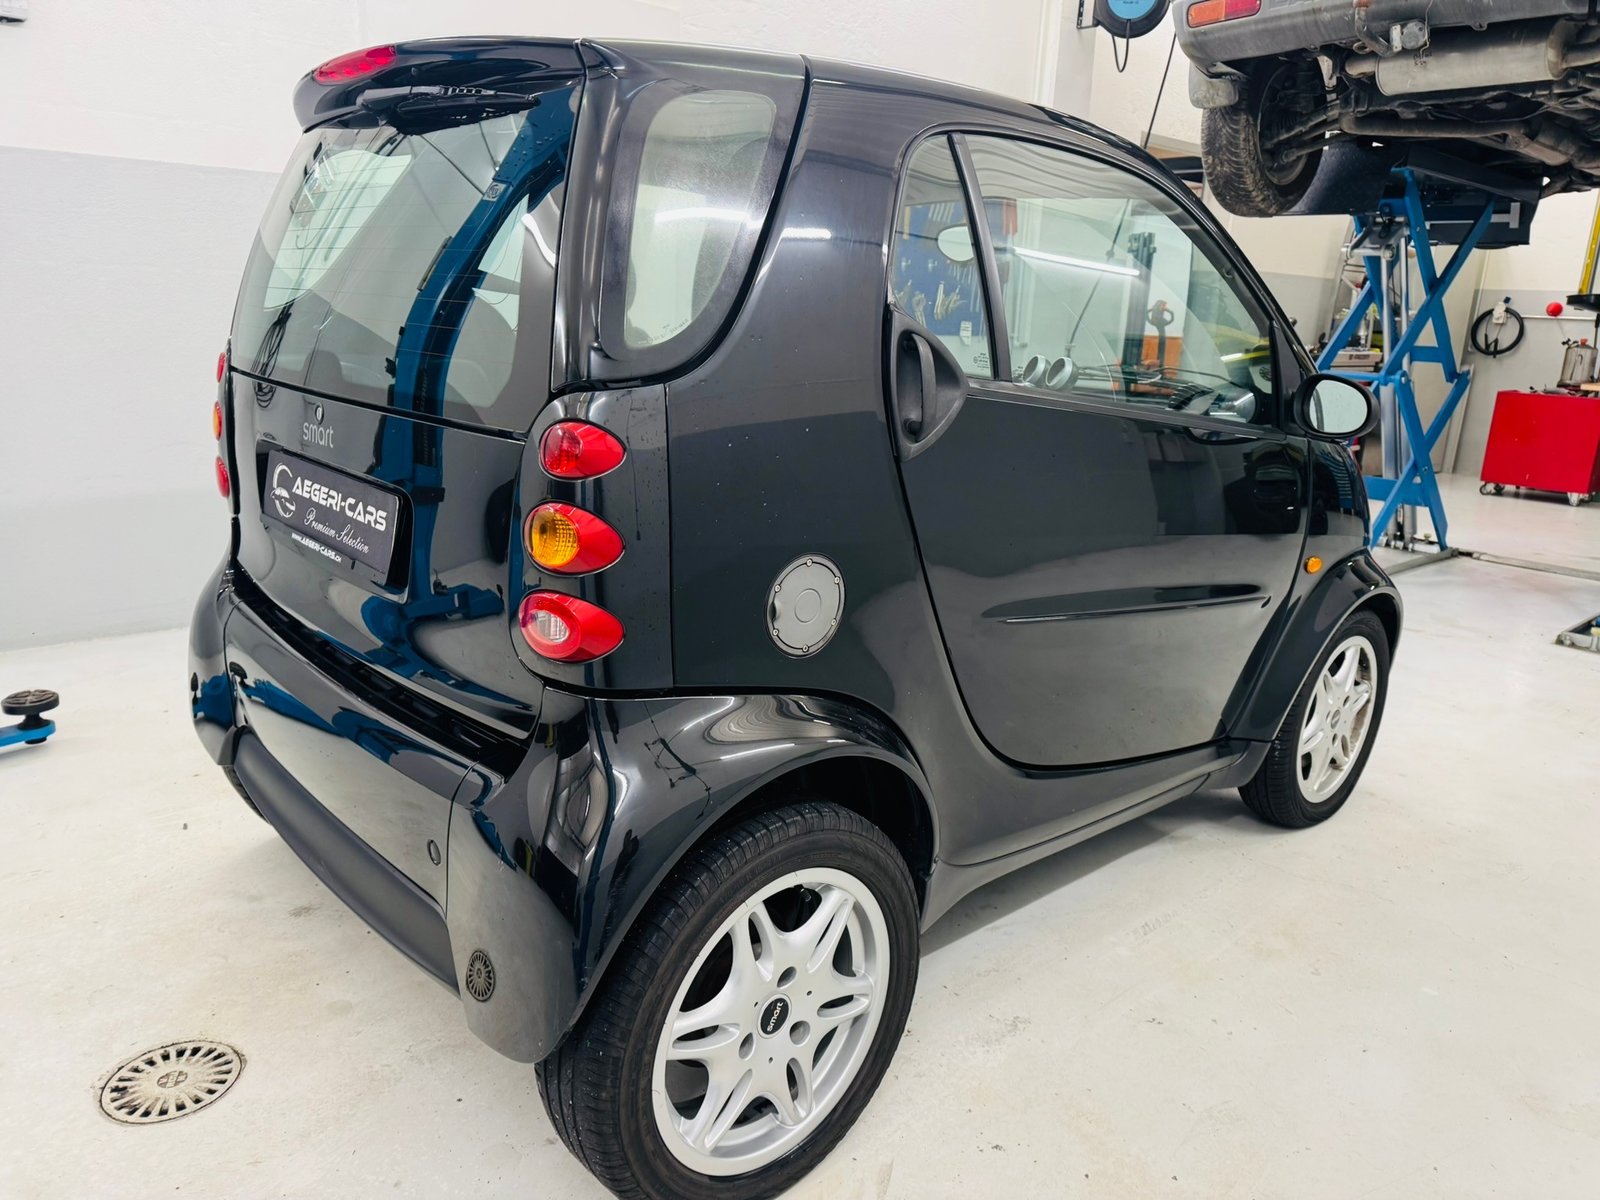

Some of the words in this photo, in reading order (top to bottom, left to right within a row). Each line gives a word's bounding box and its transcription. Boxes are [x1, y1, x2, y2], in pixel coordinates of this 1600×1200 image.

[303, 422, 334, 448] smart
[292, 477, 388, 531] AEGERI-CARS
[304, 507, 336, 538] Premium
[336, 524, 370, 554] Selection
[766, 1002, 783, 1031] smart
